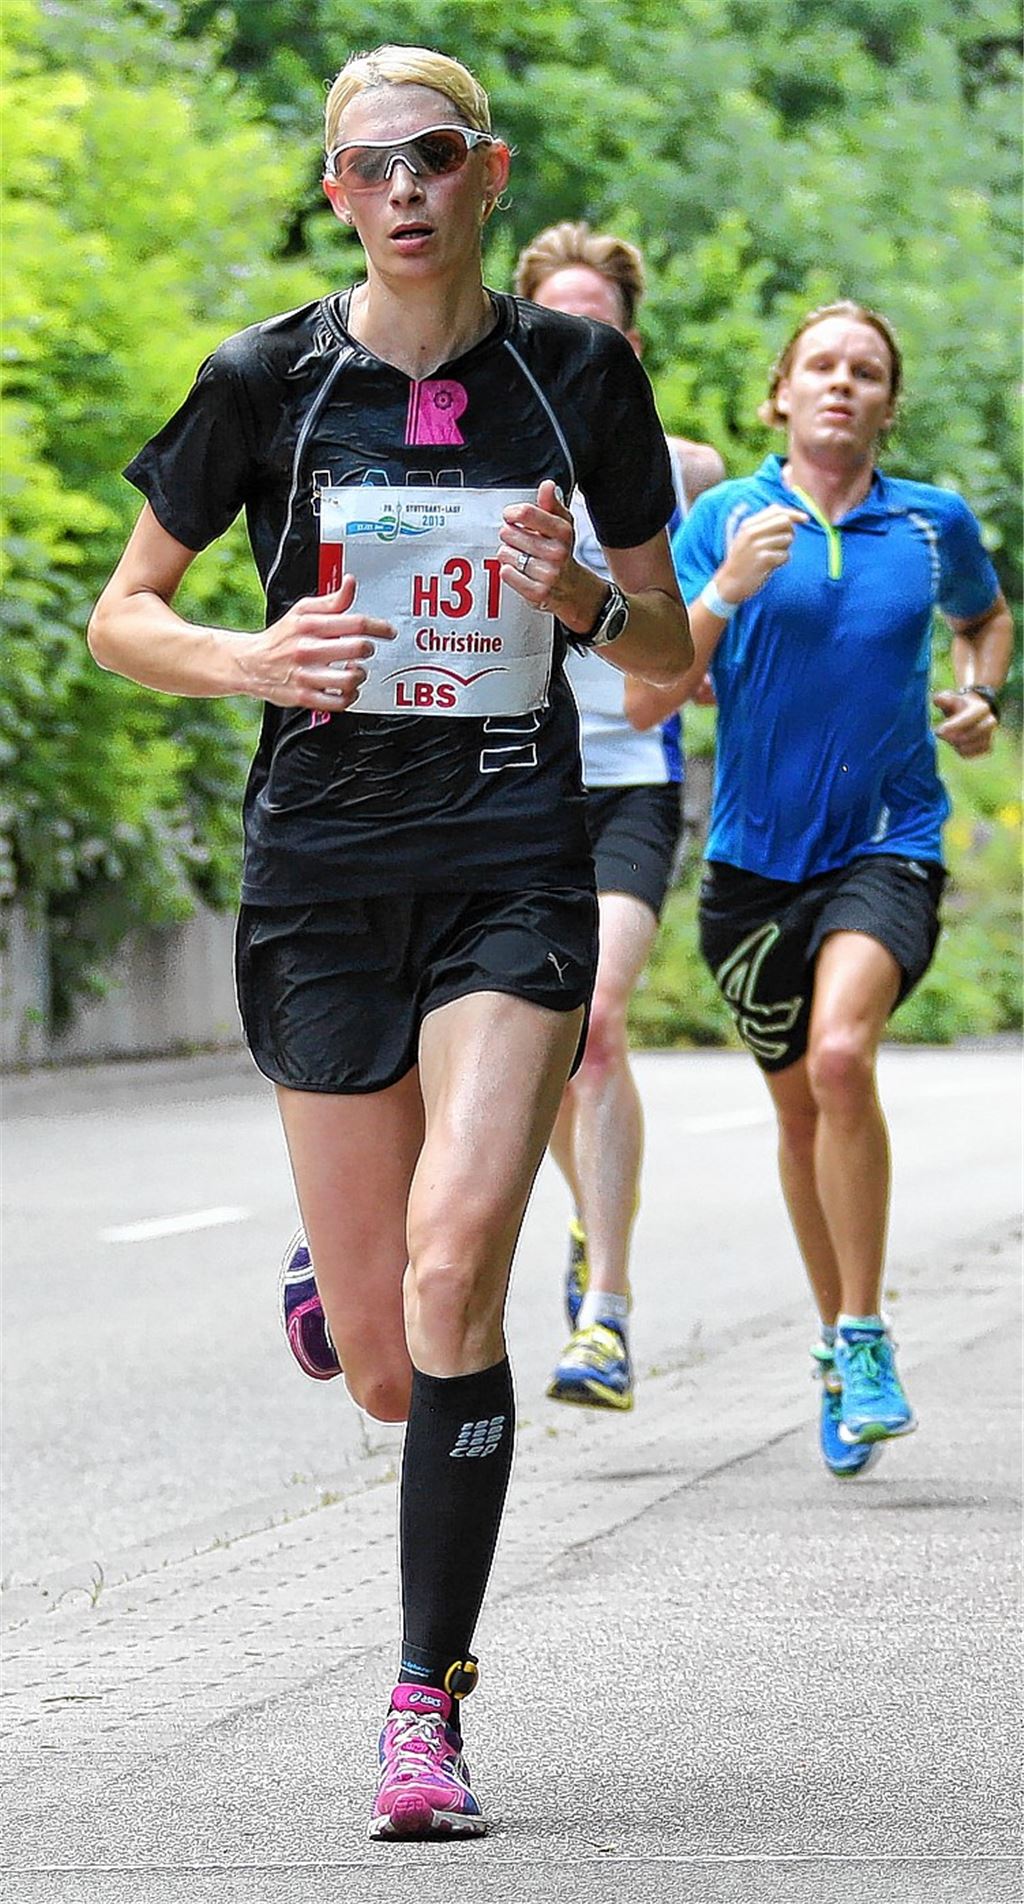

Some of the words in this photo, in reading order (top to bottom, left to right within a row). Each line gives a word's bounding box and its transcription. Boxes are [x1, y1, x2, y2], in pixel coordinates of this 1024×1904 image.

[422, 515, 446, 526] 2013
[412, 557, 500, 619] H31
[415, 627, 503, 653] Christine
[395, 682, 457, 708] LBS
[448, 1442, 499, 1459] cep
